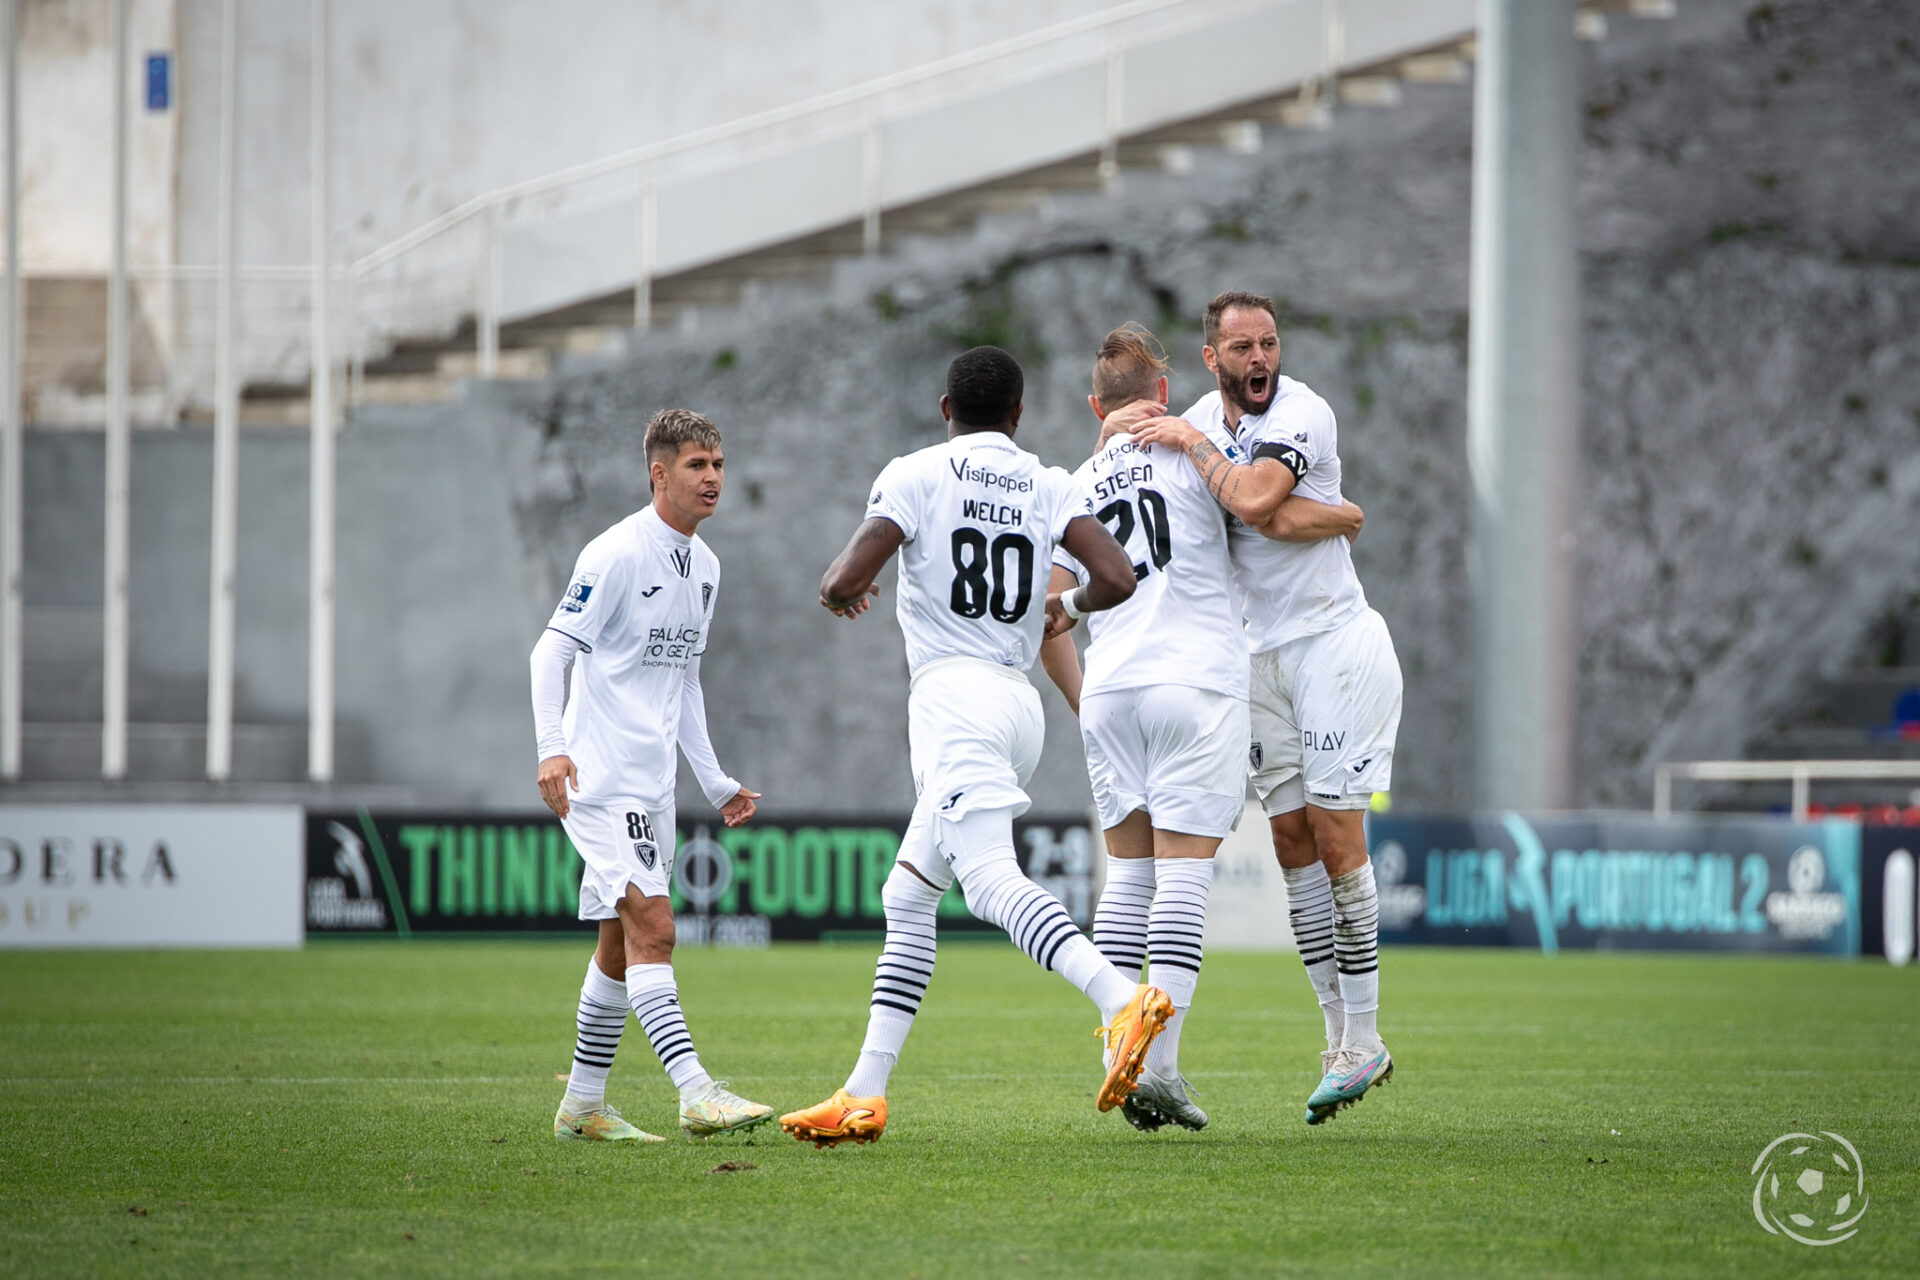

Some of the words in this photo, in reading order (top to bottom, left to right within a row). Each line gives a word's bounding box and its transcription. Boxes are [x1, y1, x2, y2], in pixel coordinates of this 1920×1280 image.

[950, 457, 1033, 493] Visipapel
[1094, 464, 1153, 501] STEEN
[963, 499, 1022, 527] WELCH
[1096, 488, 1172, 582] 20
[950, 527, 1034, 624] 80
[648, 624, 700, 643] PALÁCO
[626, 811, 654, 842] 88
[400, 824, 684, 916] THINK
[718, 826, 968, 917] FOOTB
[1426, 849, 1507, 928] LIGA
[1552, 850, 1738, 932] PORTUGAL
